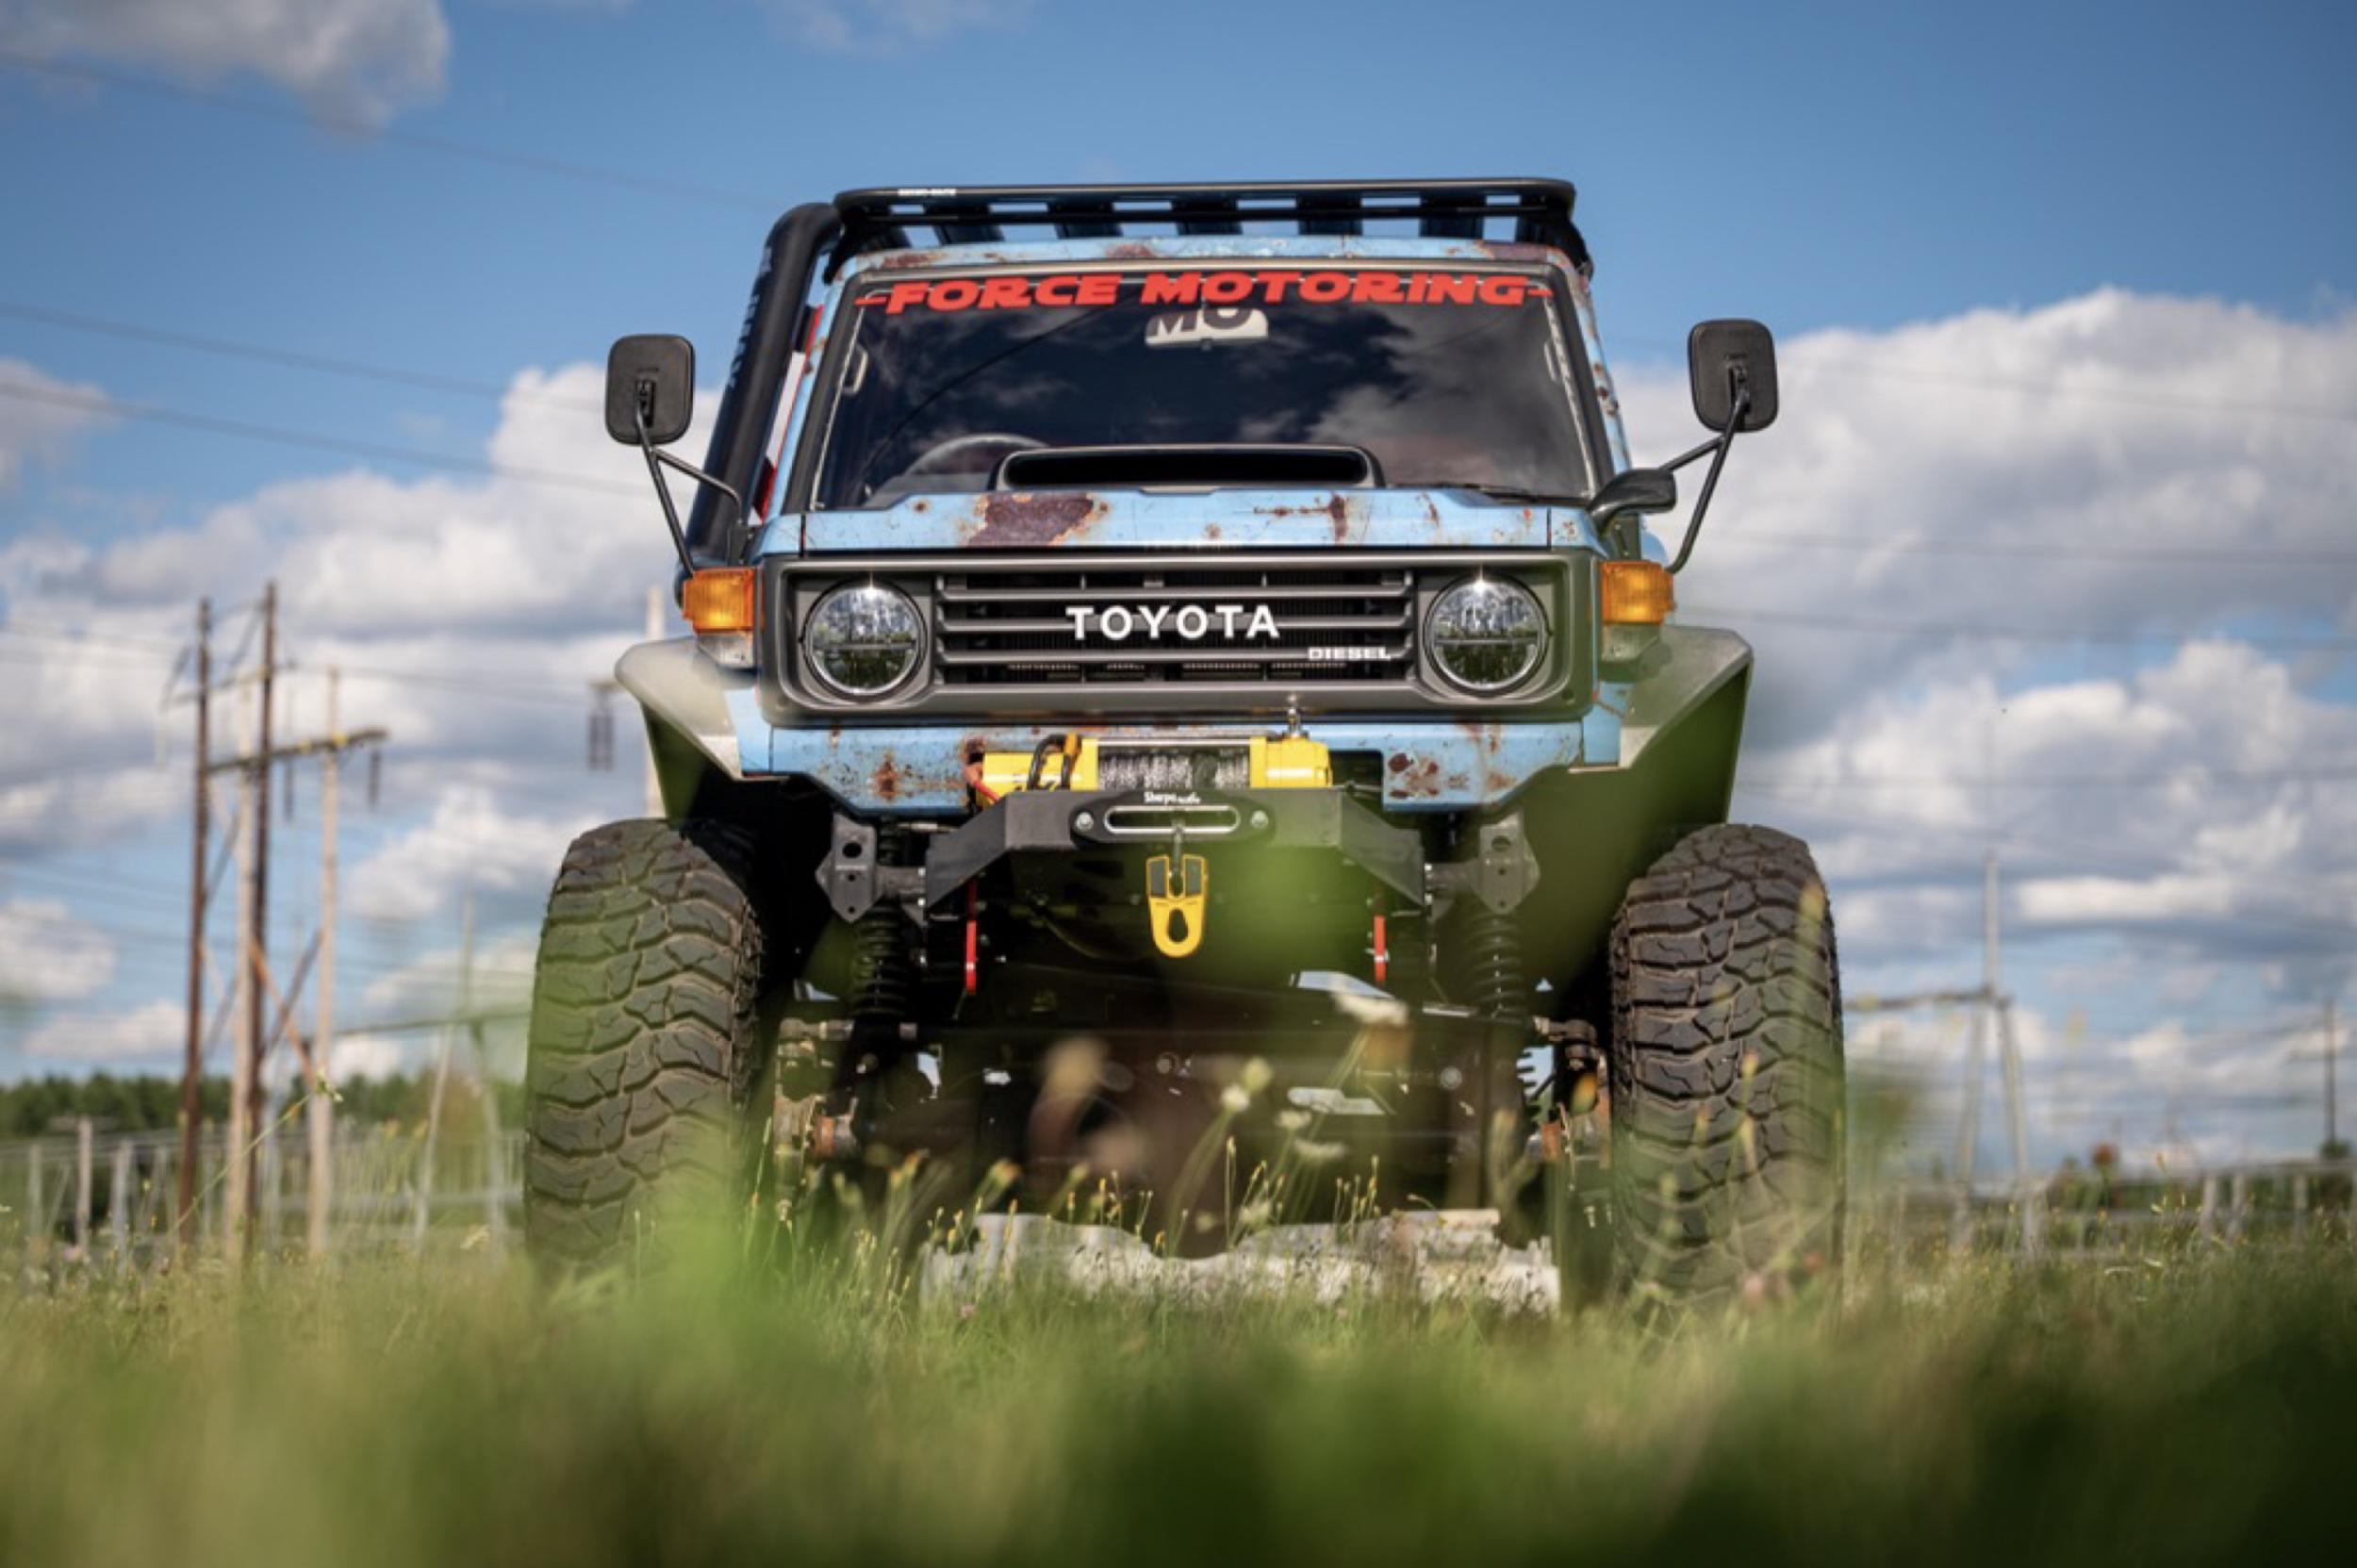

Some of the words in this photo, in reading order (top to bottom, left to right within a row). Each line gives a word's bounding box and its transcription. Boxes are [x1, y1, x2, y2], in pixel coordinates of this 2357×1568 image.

[885, 273, 1123, 314] FORCE
[1141, 271, 1528, 305] MOTORING
[1065, 605, 1279, 641] TOYOTA
[1308, 646, 1391, 661] DIESEL
